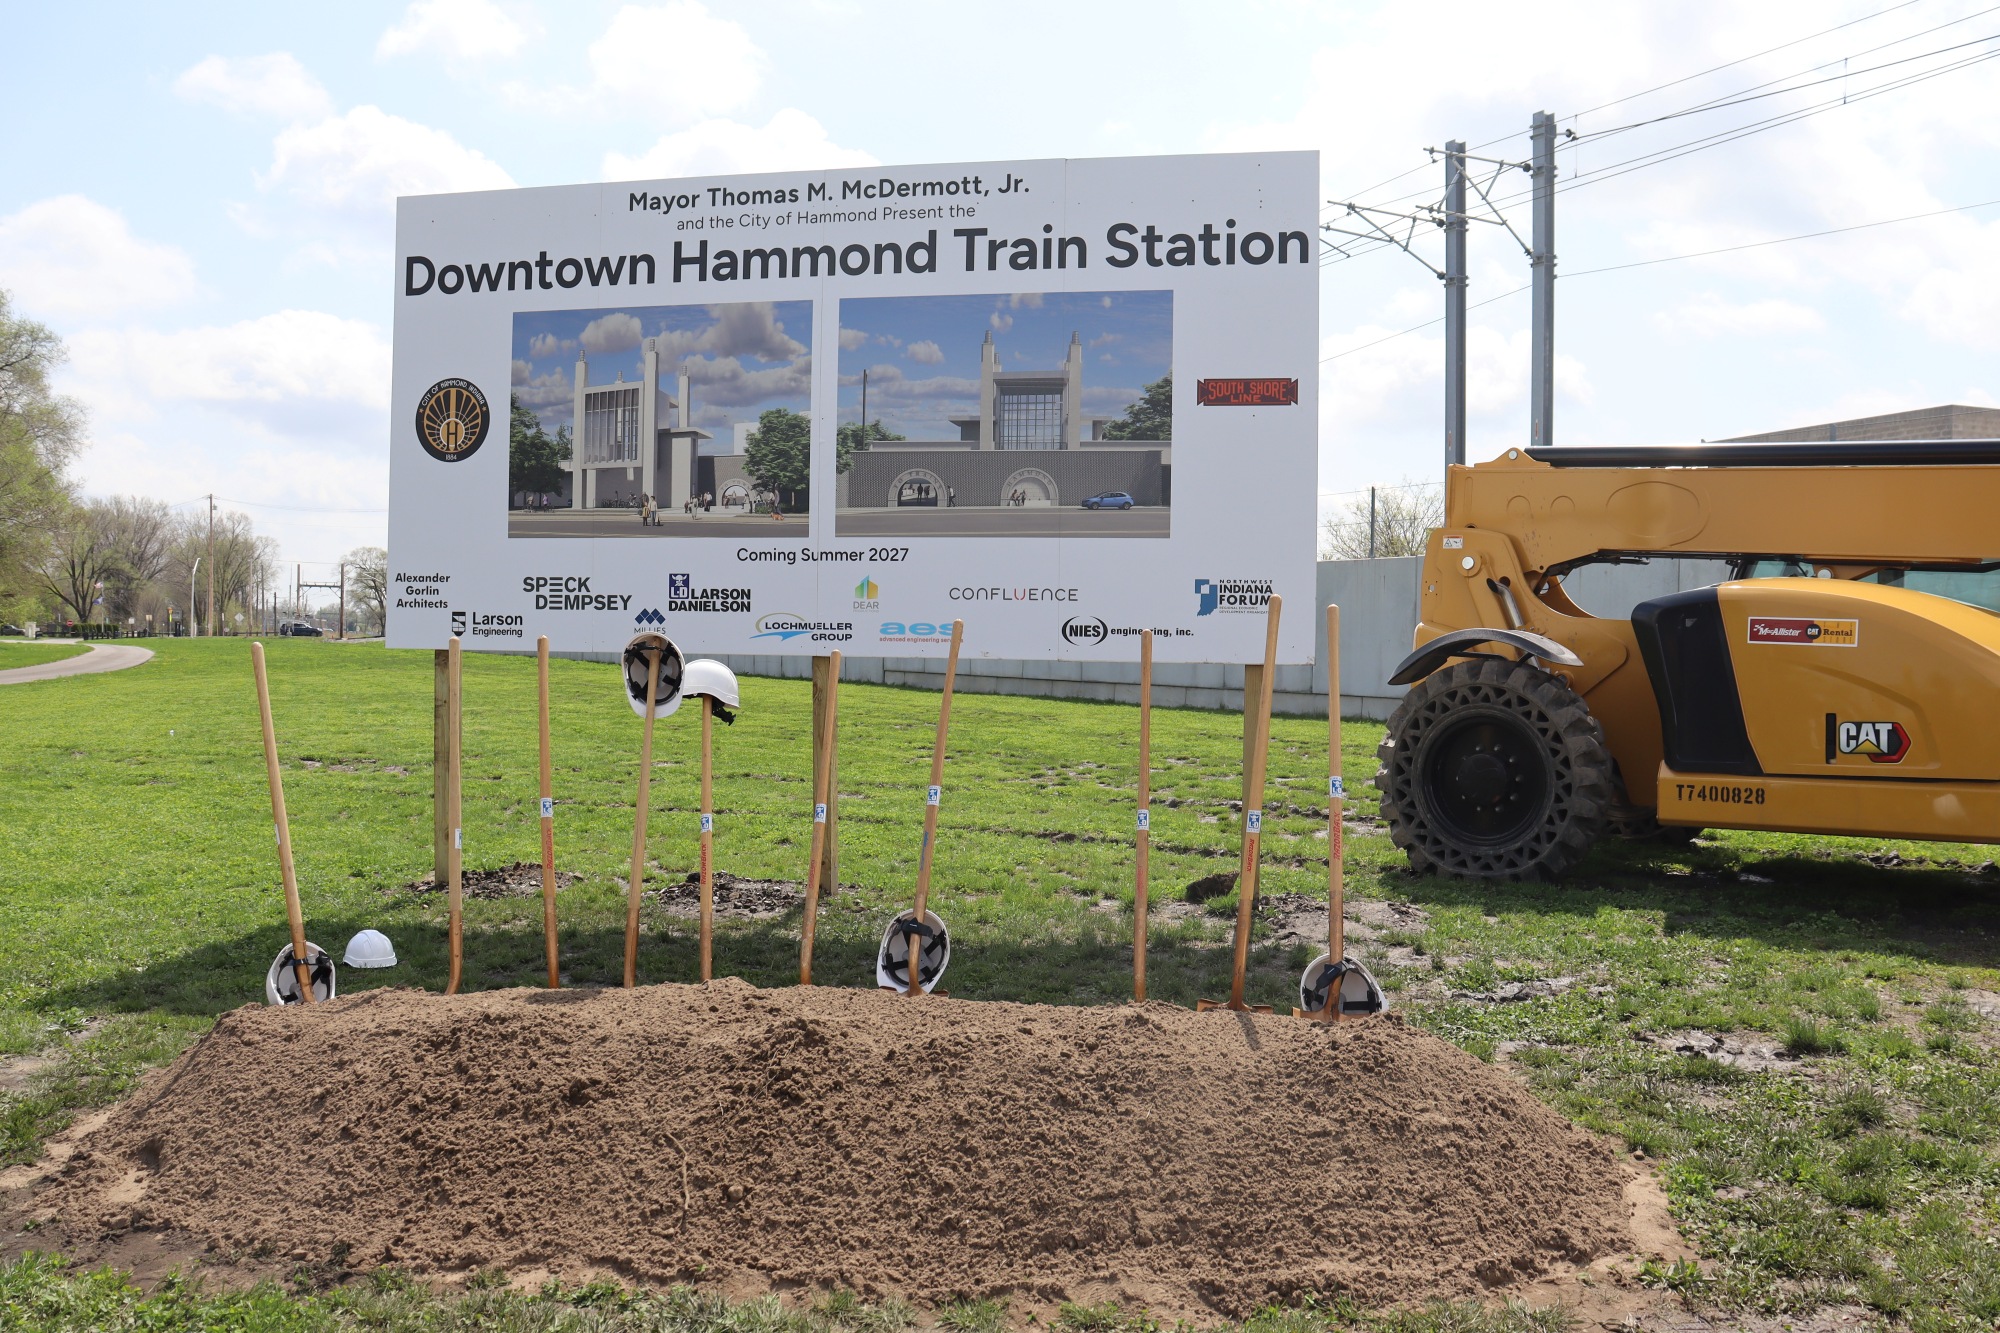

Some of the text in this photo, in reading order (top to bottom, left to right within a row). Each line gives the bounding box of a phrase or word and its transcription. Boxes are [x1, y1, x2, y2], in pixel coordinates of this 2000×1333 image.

[630, 173, 1030, 214] Mayor Thomas M. McDermott, Jr.
[677, 203, 976, 231] and the City of Hammond Present the
[405, 218, 1310, 297] Downtown Hammond Train Station
[421, 392, 433, 406] CITY
[431, 385, 439, 394] OF
[468, 385, 486, 405] INDIANA
[1208, 381, 1288, 401] SOUTH SHORE
[1230, 394, 1262, 403] LINE
[737, 547, 909, 565] Coming Summer 2027
[395, 573, 451, 583] Alexander
[523, 576, 591, 593] SPECK
[405, 586, 440, 596] Gorlin
[690, 588, 751, 600] LARSON
[949, 587, 1079, 602] CONFLUENCE
[1219, 584, 1273, 594] INDIANA
[396, 598, 448, 609] Architects
[535, 594, 633, 611] DEMPSEY
[668, 600, 751, 612] DANIELSON
[852, 601, 880, 610] DEAR
[1219, 594, 1271, 606] FORUM
[472, 612, 523, 626] Larson
[765, 621, 853, 631] LOCHMUELLER
[472, 627, 523, 638] Engineering
[879, 622, 953, 636] aes
[1069, 624, 1194, 638] NIES engineing, inc.
[1823, 628, 1853, 637] Rental
[811, 633, 853, 642] GROUP
[1839, 722, 1893, 754] CAT
[1675, 783, 1766, 805] T7400828
